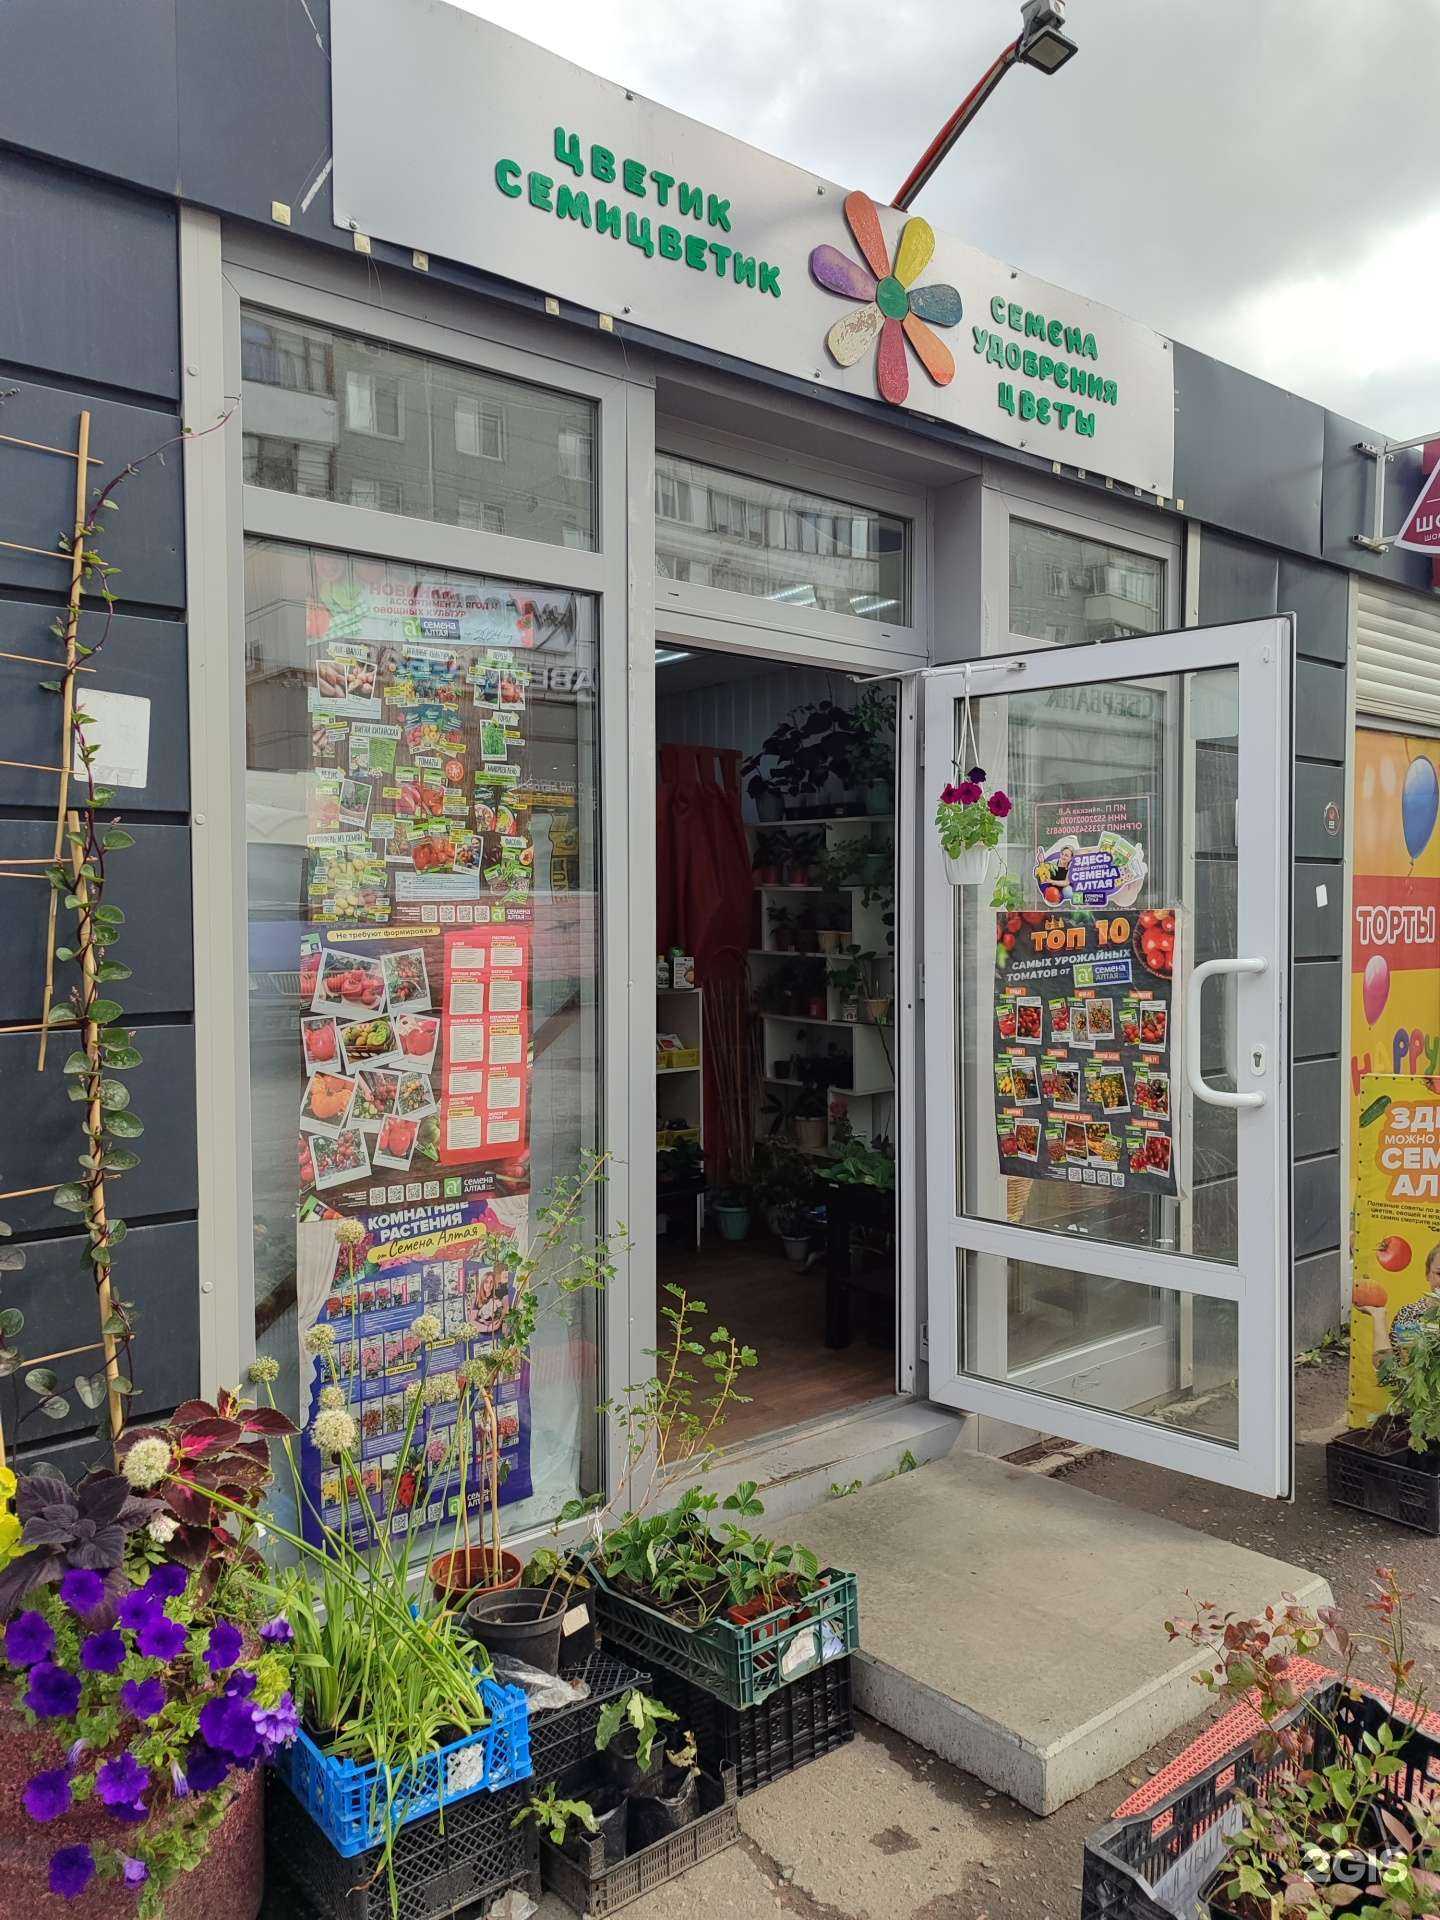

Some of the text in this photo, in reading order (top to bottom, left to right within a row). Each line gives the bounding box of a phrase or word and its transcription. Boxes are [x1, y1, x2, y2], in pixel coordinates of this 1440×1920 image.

[554, 127, 732, 233] ЦВЕТИК
[495, 158, 782, 298] СЕМИЦВЕТИК
[990, 295, 1098, 361] СЕМЕНА
[972, 326, 1118, 406] УДОБРЕНИЯ
[998, 382, 1095, 438] ЦВЕТЫ
[1071, 867, 1118, 881] СЕМЕНА
[1074, 853, 1111, 866] ЗДЕСЬ
[1075, 879, 1113, 891] АЛТАЯ
[1031, 917, 1131, 952] ТОП 10
[1356, 906, 1435, 945] ТОРТЫ
[1012, 948, 1131, 971] САМЫХ УРОЖАЙНЫХ
[1006, 969, 1058, 982] ТОМАТОВ
[1385, 1134, 1435, 1145] МОЖНО
[464, 1184, 486, 1193] АЛТАЯ
[380, 1212, 463, 1242] РАСТЕНИЯ
[389, 1237, 434, 1258] Семена
[437, 1227, 478, 1246] Алтая
